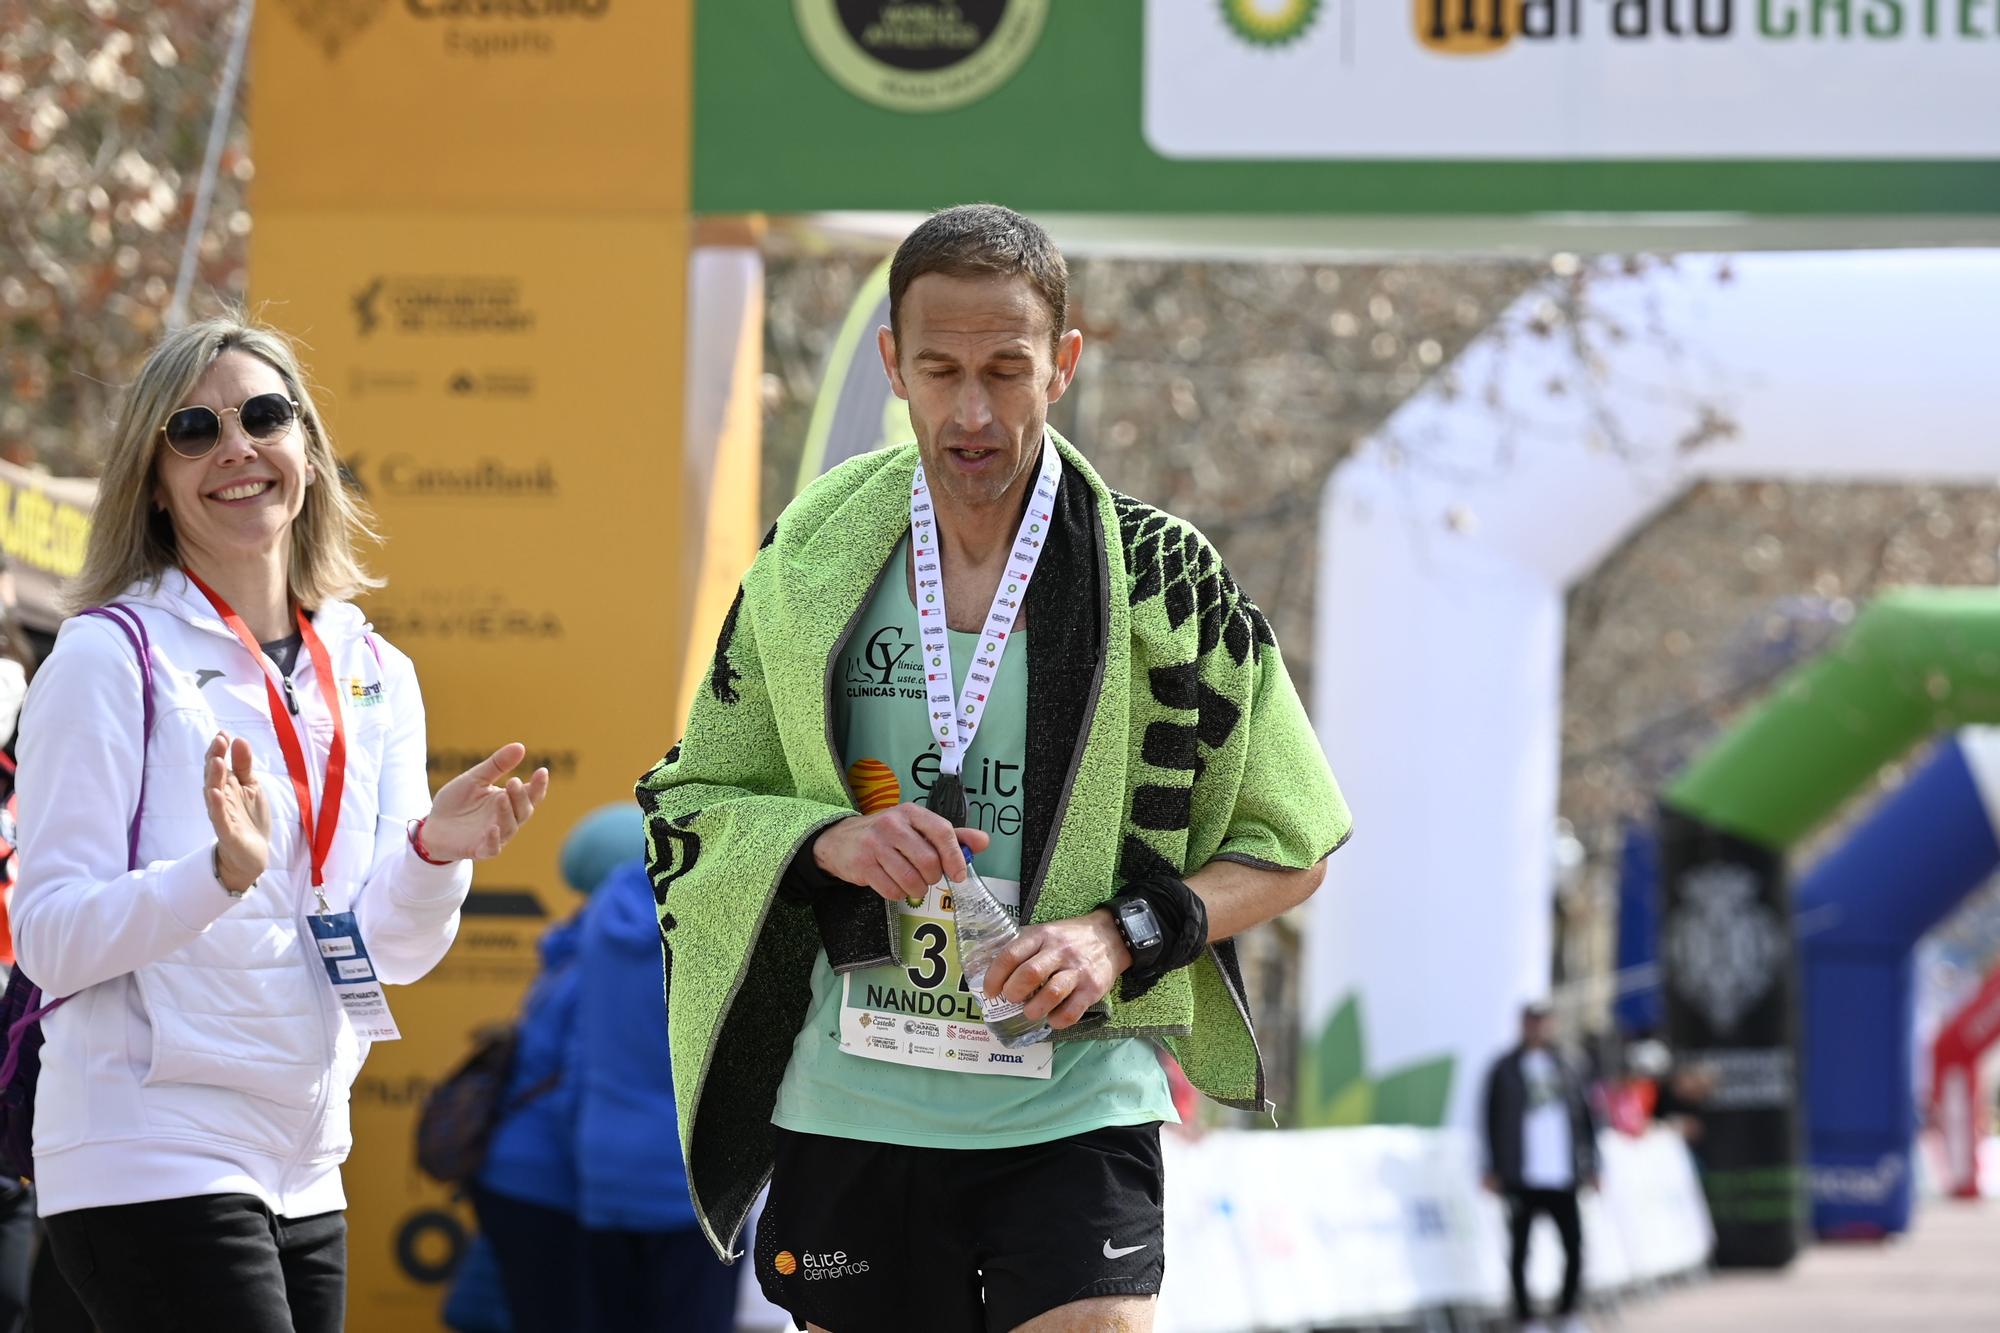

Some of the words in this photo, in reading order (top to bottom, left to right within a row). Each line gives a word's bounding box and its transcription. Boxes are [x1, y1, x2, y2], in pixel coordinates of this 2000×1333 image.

[897, 660, 926, 671] línica
[846, 685, 896, 698] CLÍNICAS
[898, 688, 928, 699] YUST
[866, 984, 983, 1021] NANDO-L
[958, 1027, 988, 1036] Diputació
[804, 1260, 869, 1280] cementos
